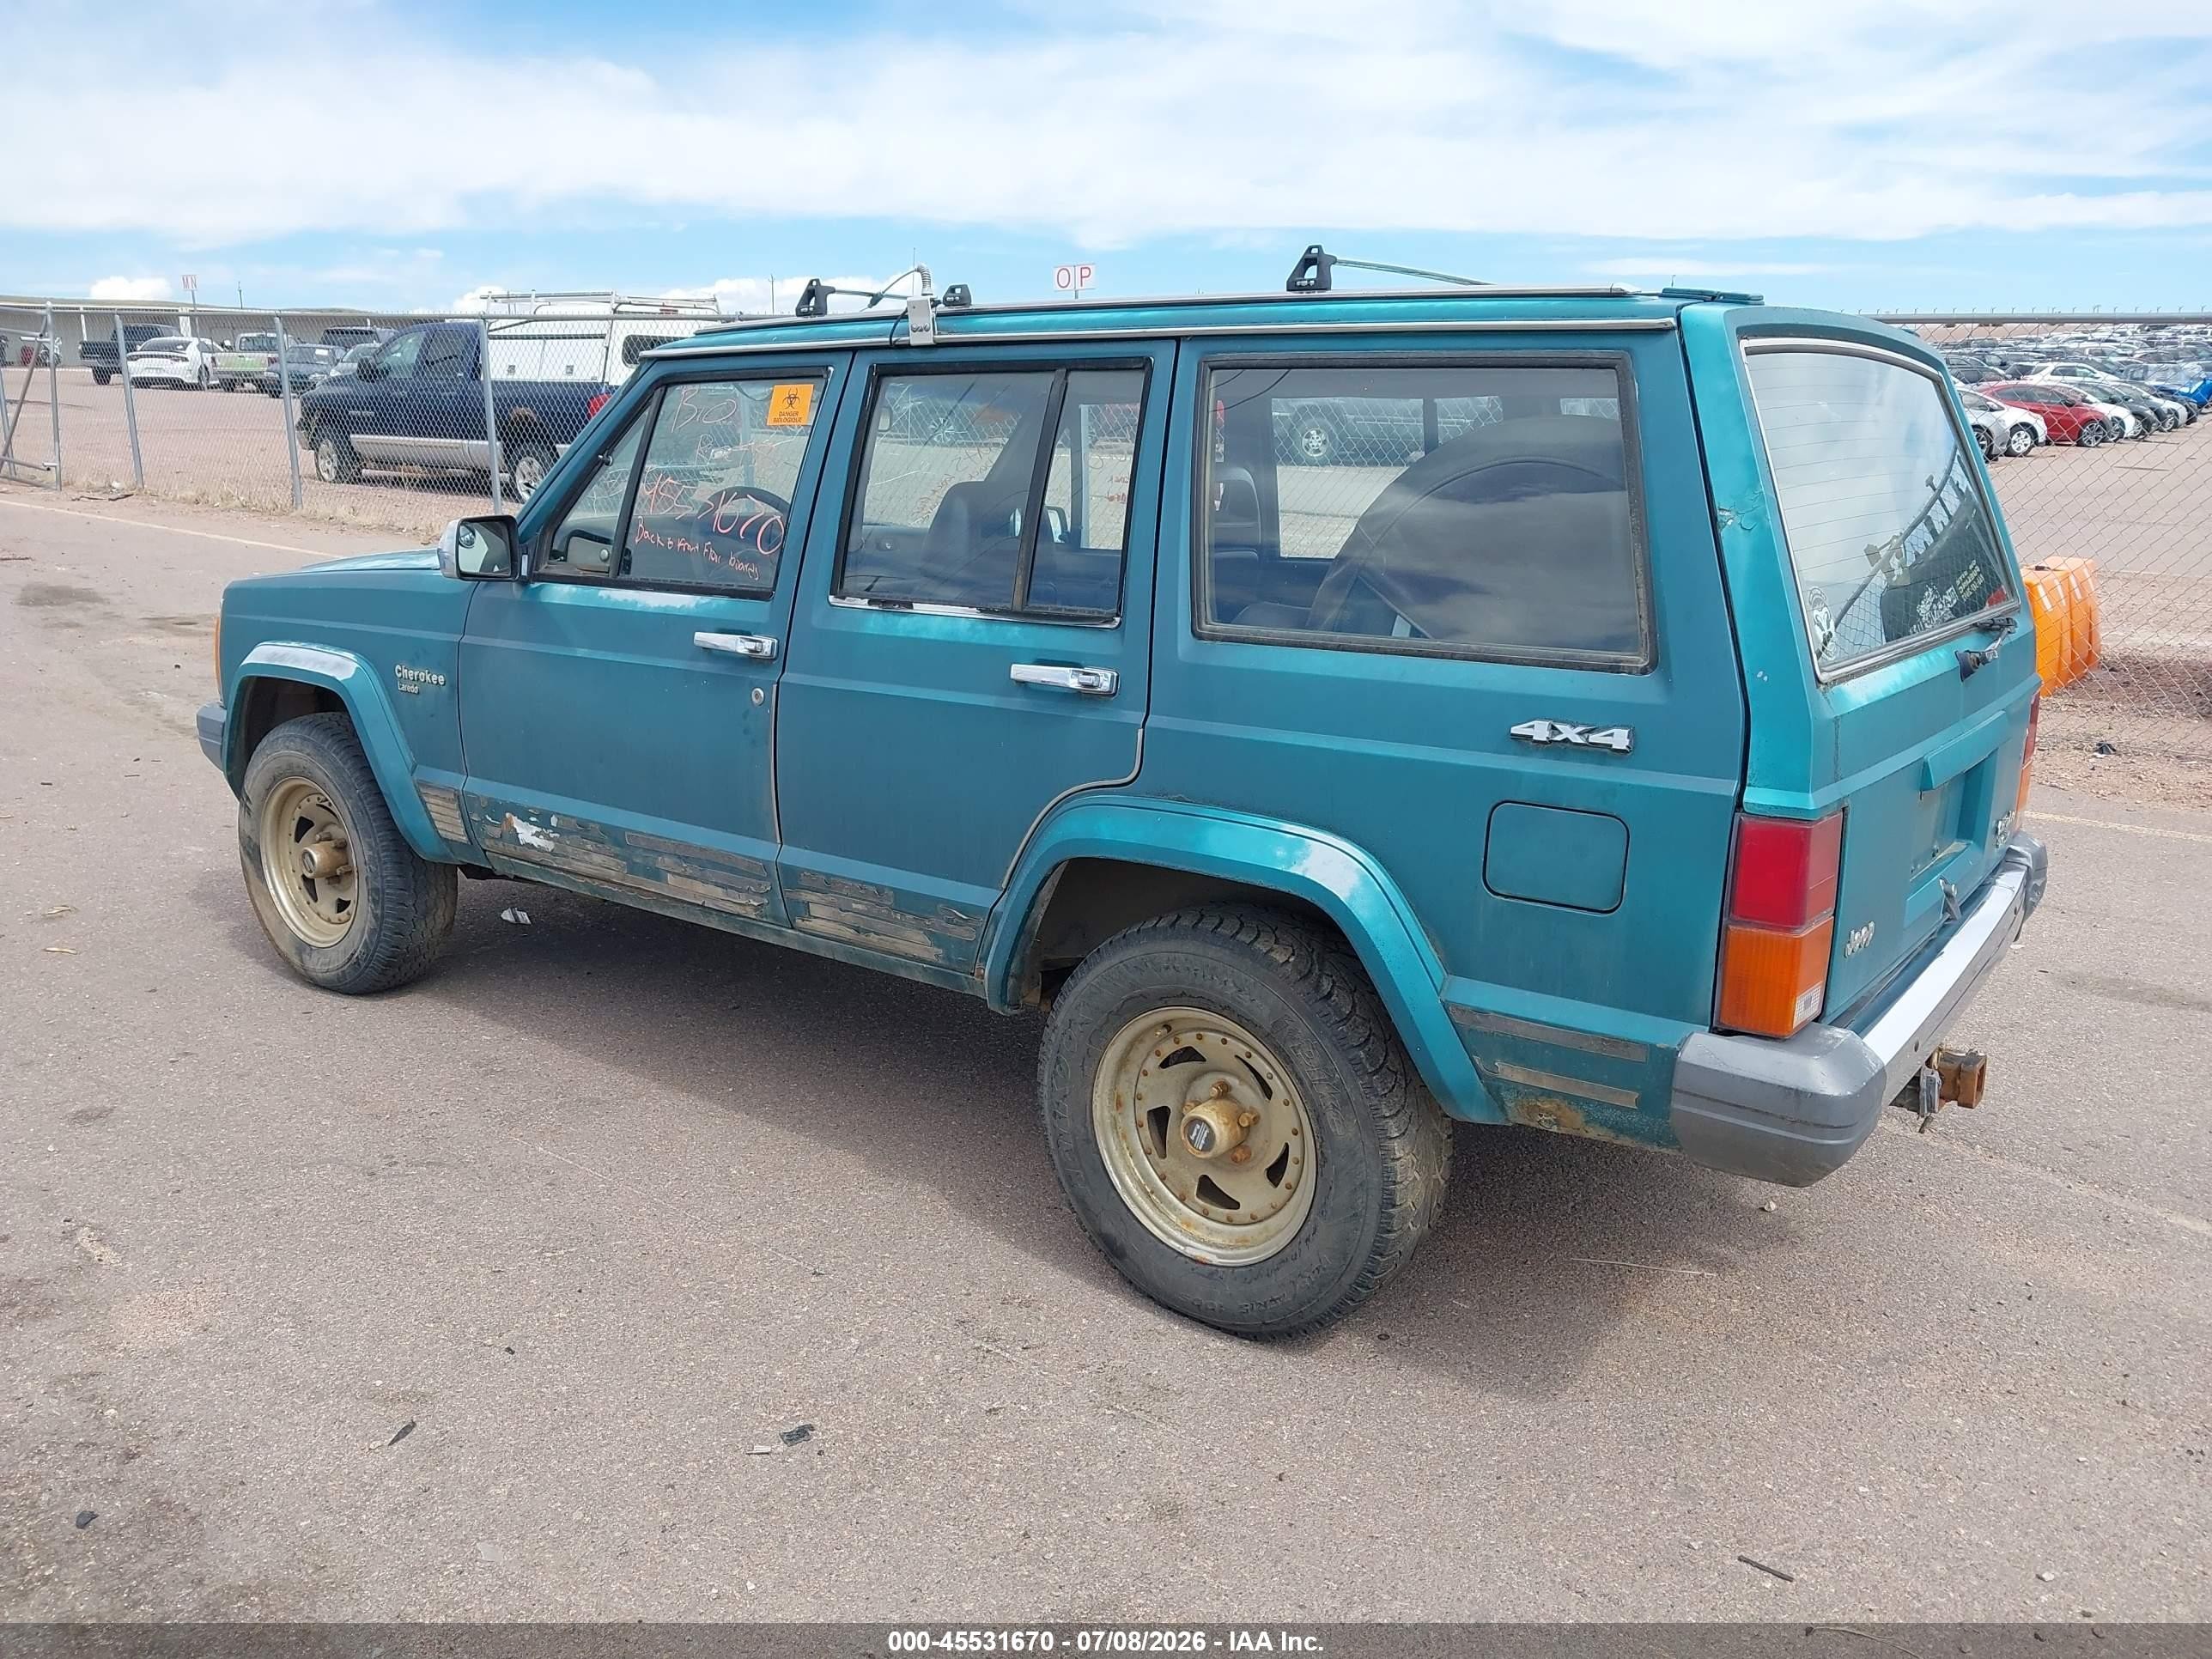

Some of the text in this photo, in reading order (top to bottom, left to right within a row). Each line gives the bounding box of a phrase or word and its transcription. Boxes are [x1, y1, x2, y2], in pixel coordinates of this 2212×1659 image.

[635, 516, 665, 547] Back
[395, 665, 445, 685] Cherokee
[1844, 921, 1875, 958] Jeep
